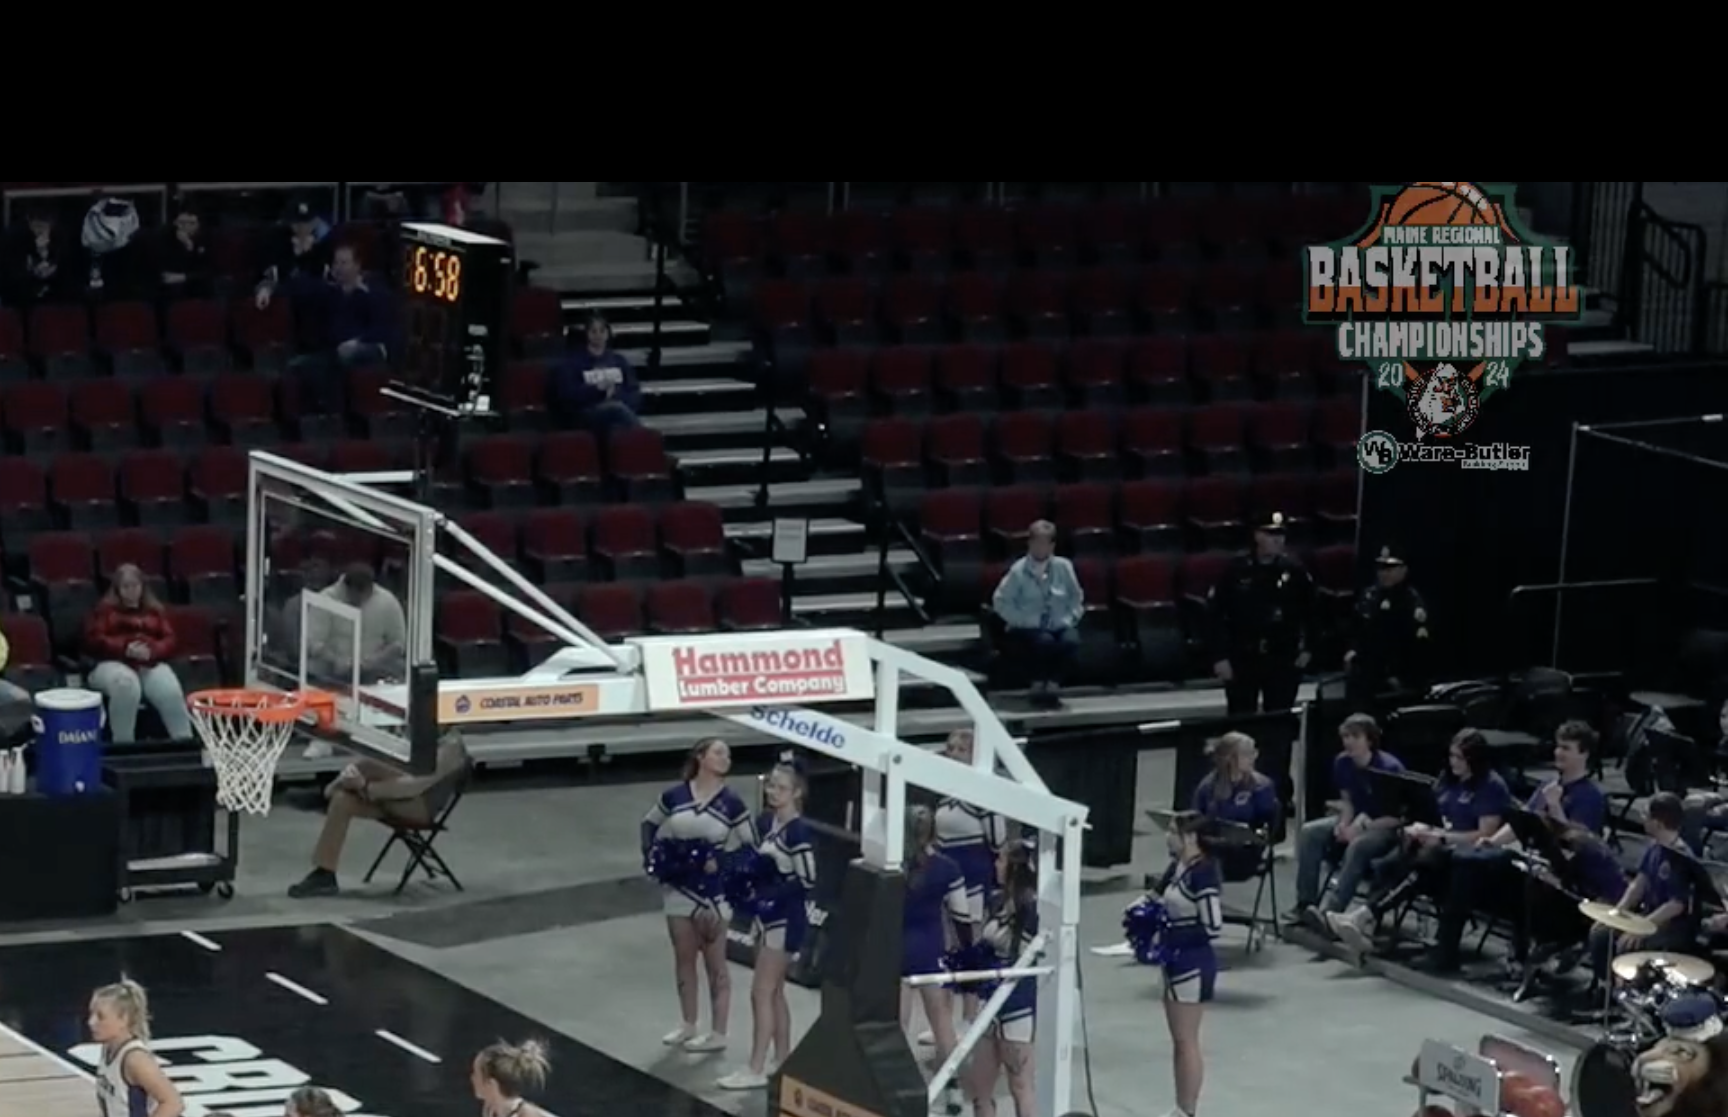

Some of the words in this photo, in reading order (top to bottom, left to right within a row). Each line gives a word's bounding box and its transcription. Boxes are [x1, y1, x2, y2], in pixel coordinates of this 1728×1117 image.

[414, 246, 460, 301] 6:58
[673, 642, 844, 676] Hammond
[678, 678, 750, 698] Lumber
[753, 674, 846, 696] Company
[750, 706, 846, 748] Schelde
